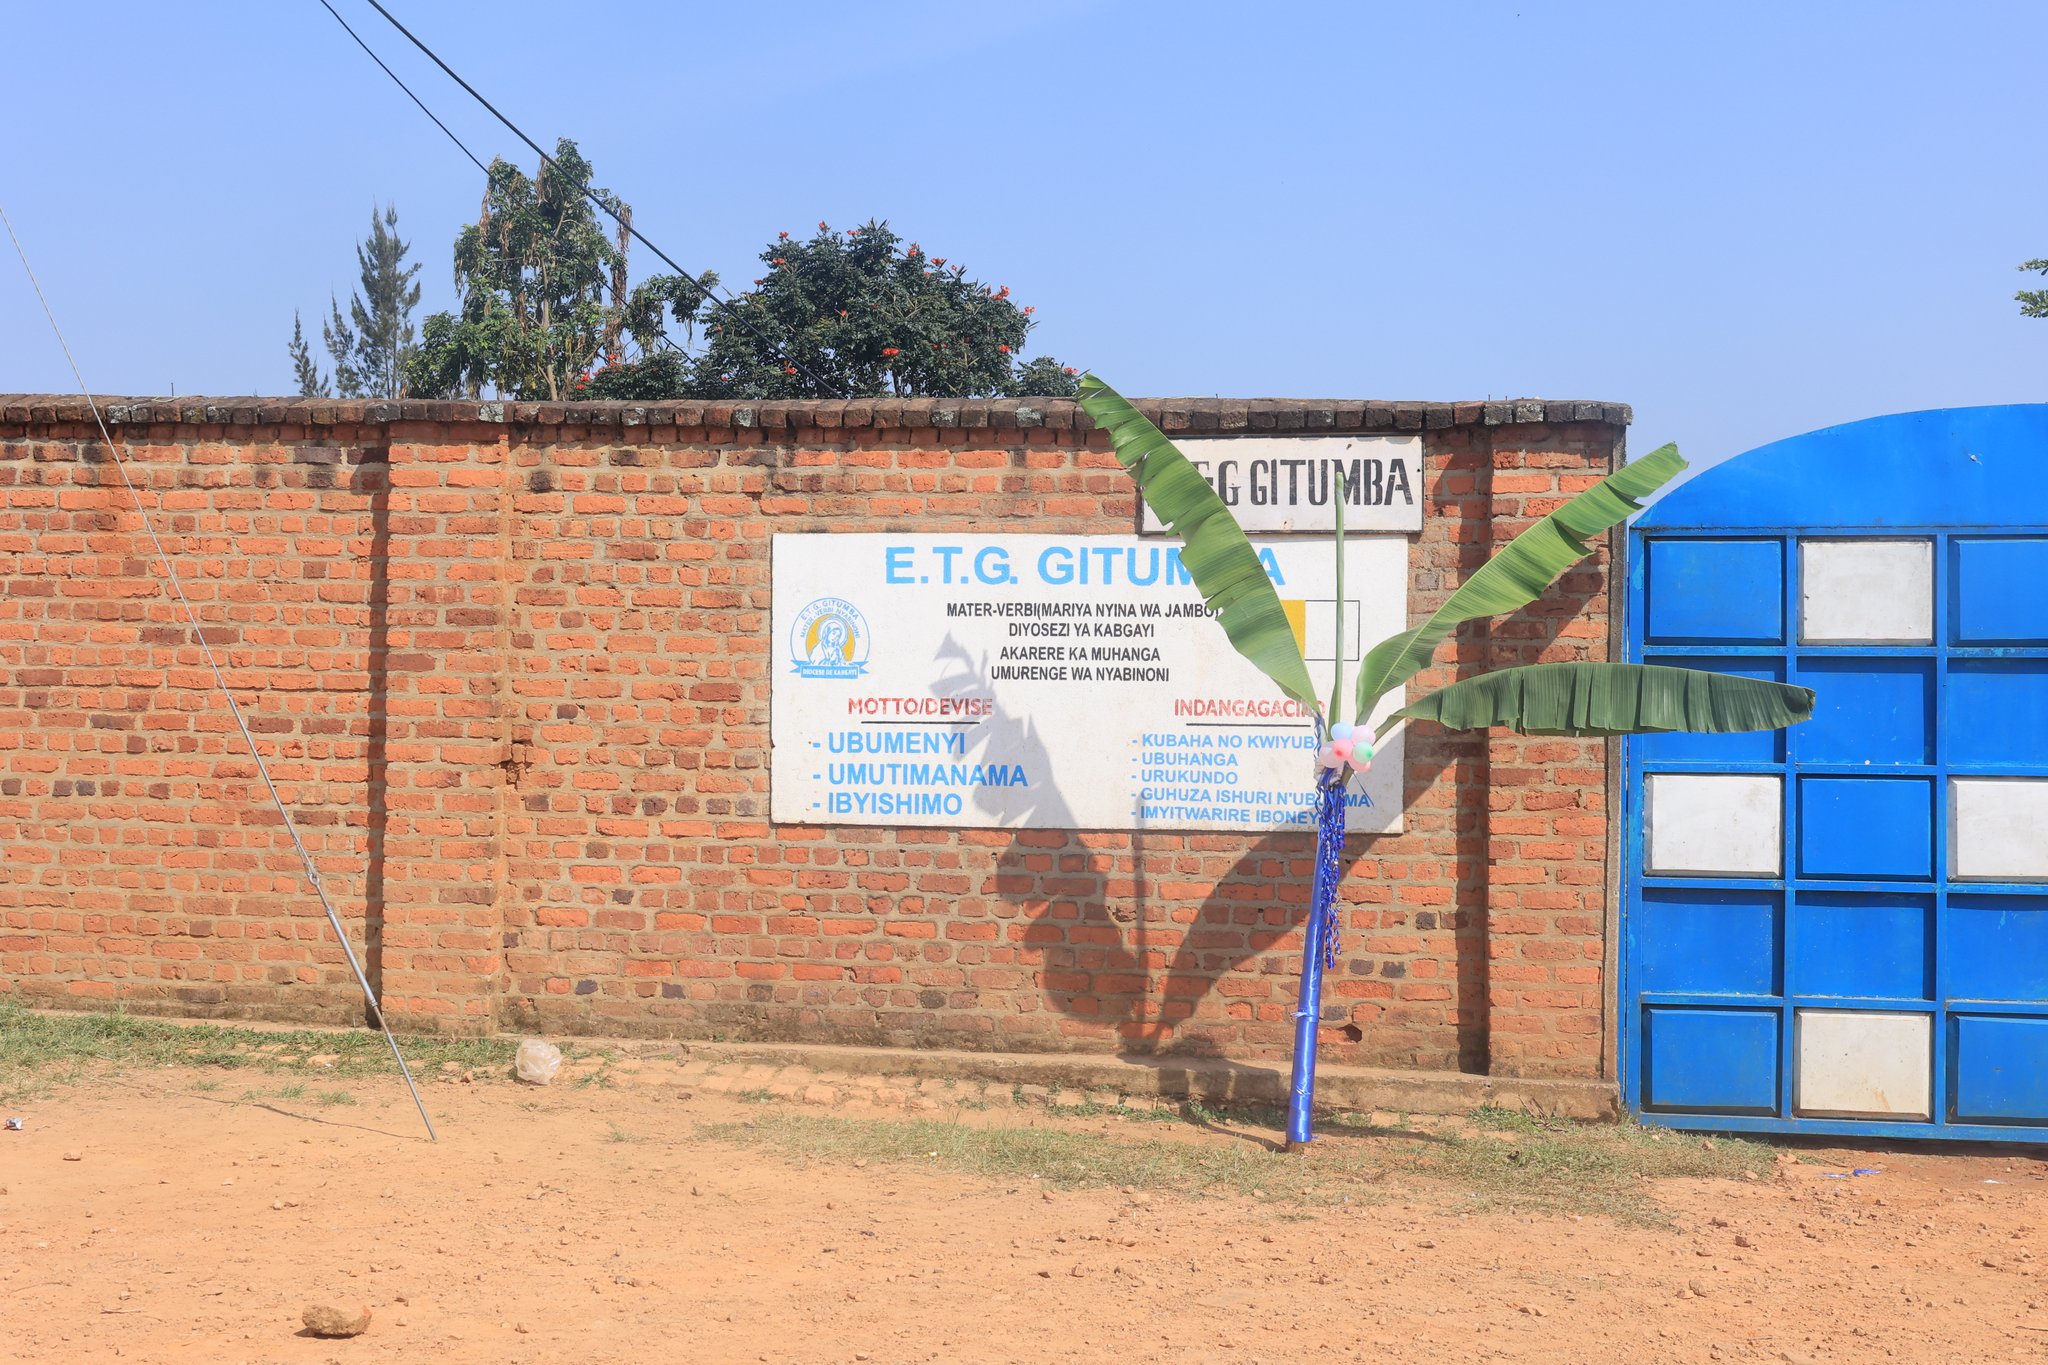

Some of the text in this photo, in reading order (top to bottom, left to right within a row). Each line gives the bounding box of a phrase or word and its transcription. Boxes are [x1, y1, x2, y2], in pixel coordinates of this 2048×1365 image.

[1249, 458, 1414, 506] GITUMBA
[885, 545, 1286, 587] E.T.G. GITUMA
[822, 600, 858, 620] GITUMBA
[1096, 604, 1137, 618] NYINA
[1141, 604, 1162, 618] WA
[1009, 622, 1154, 638] DIYOSEZI YA KABGAYI
[1000, 646, 1161, 662] AKARERE KA MUHANGA
[991, 666, 1169, 682] UMURENGE WA NYABINONI
[848, 697, 992, 716] MOTTO/DEVISE
[828, 732, 966, 755] UBUMENYI
[1142, 734, 1211, 748] KUBAHA
[1217, 735, 1243, 749] NO
[1247, 735, 1316, 750] KWIYUB
[1141, 752, 1238, 767] UBUHANGA
[828, 763, 1029, 787] UMUTIMANAMA
[1141, 770, 1238, 785] URUKUNDO
[828, 792, 963, 815] IBYISHIMO
[1140, 787, 1211, 803] GUHUZA
[1216, 790, 1273, 805] ISHURI
[1140, 806, 1250, 823] IMYITWARIRE
[1255, 809, 1319, 825] IBONEY
